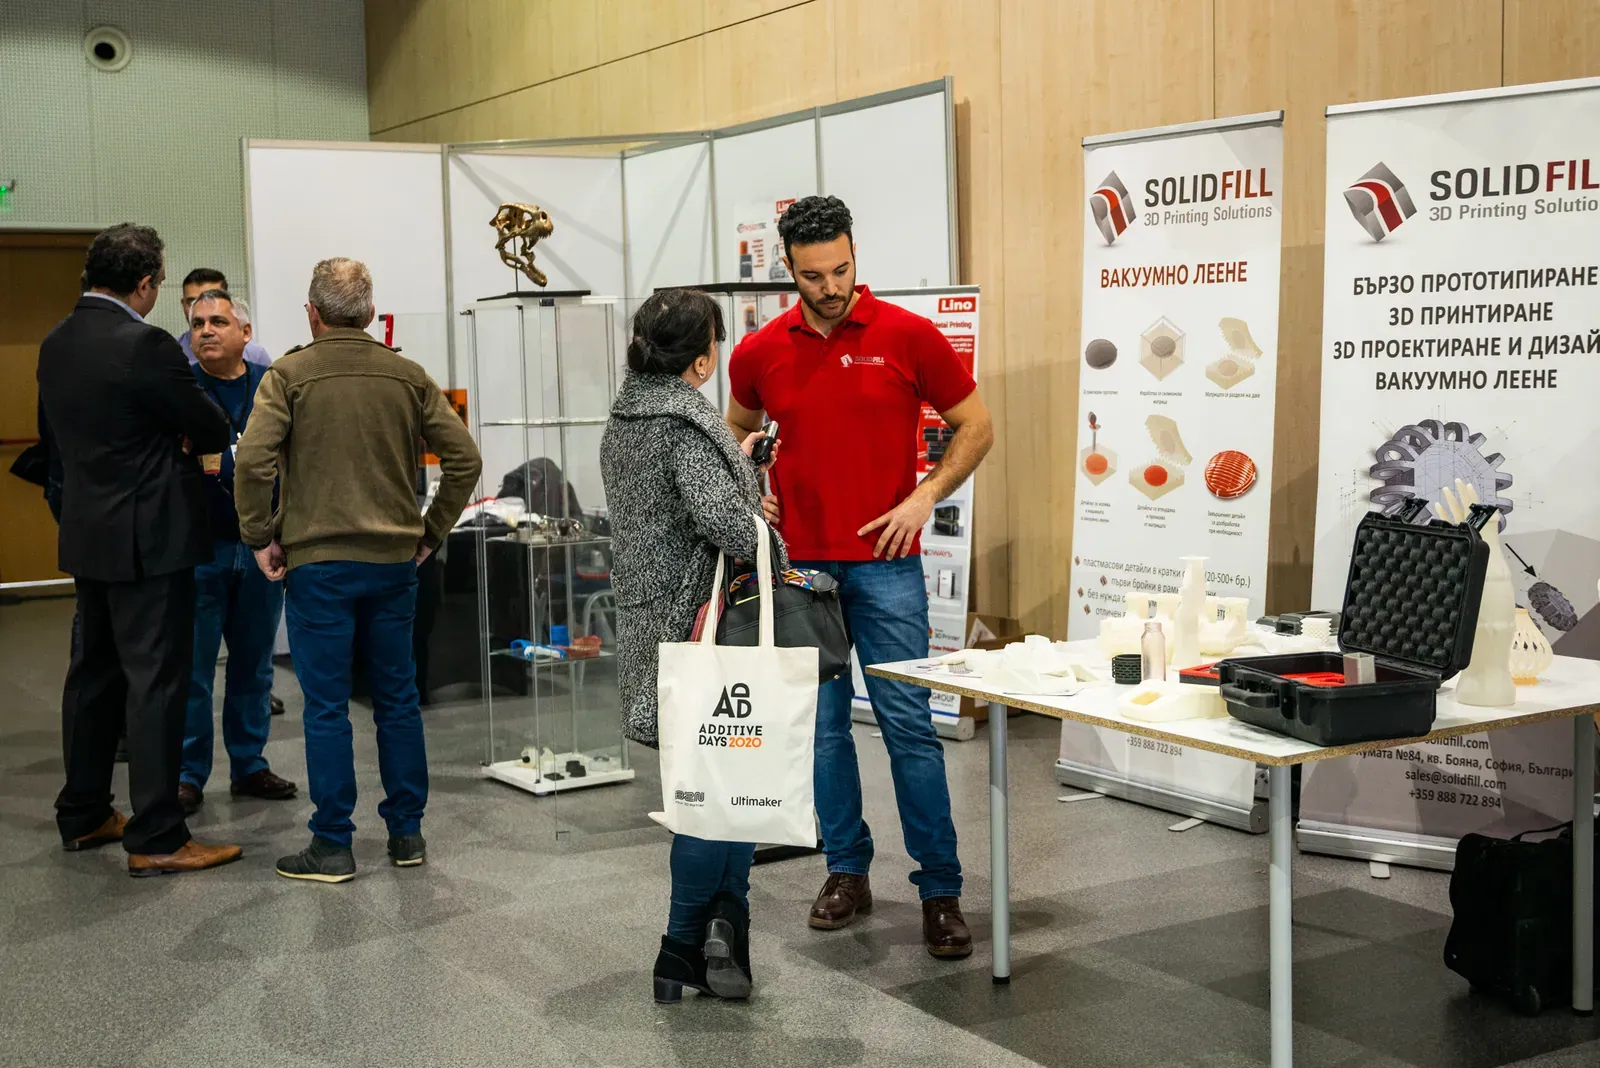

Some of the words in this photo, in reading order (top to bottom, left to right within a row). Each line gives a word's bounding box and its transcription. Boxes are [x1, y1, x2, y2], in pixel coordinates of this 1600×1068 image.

[1144, 167, 1273, 208] SOLIDFILL
[1429, 159, 1600, 202] SOLIDFIL
[1143, 212, 1160, 227] 3D
[1164, 208, 1209, 226] Printing
[1213, 205, 1273, 221] Solutions
[1428, 206, 1452, 221] 3D
[1459, 202, 1527, 220] Printing
[1534, 196, 1599, 215] Solutio
[1100, 264, 1189, 289] ВАКУУМНО
[1193, 261, 1248, 284] ЛЕЕНЕ
[1353, 274, 1415, 295] БЪРЗО
[1421, 266, 1599, 293] ПРОТОТИПИРАНЕ
[941, 299, 973, 312] Lino
[1388, 307, 1414, 326] 3D
[1420, 302, 1553, 325] ПРИНТИРАНЕ
[949, 320, 972, 330] Printing
[1333, 341, 1355, 360] 3D
[1361, 336, 1501, 359] ПРОЕКТИРАНЕ
[1508, 336, 1522, 356] И
[1528, 328, 1600, 360] ДИЗАЙ
[1375, 370, 1487, 390] ВАКУУМНО
[1493, 369, 1558, 389] ЛЕЕНЕ
[1083, 557, 1124, 570] пластмасови
[1124, 561, 1152, 574] детайли
[1157, 567, 1181, 578] кратки
[1111, 577, 1132, 589] първи
[1132, 578, 1156, 591] бройки
[1235, 574, 1251, 588] бр.)
[1087, 588, 1099, 599] без
[1099, 591, 1121, 603] нужда
[1095, 606, 1120, 618] отличен
[698, 723, 763, 736] ADDITIVE
[698, 734, 728, 747] DAYS
[728, 736, 762, 748] 2020
[1126, 736, 1142, 748] +359
[1142, 739, 1155, 751] 888
[1156, 742, 1169, 754] 722
[1169, 745, 1182, 757] 894
[1426, 756, 1442, 765] кв.
[1445, 754, 1482, 770] Бояна,
[1485, 758, 1525, 774] София,
[1528, 764, 1574, 779] Българи
[1405, 770, 1507, 791] sales@solidfill.com
[730, 796, 783, 808] Ultimaker
[1408, 789, 1434, 801] +359
[1437, 791, 1457, 804] 888
[1459, 794, 1478, 806] 722
[1481, 796, 1501, 809] 894
